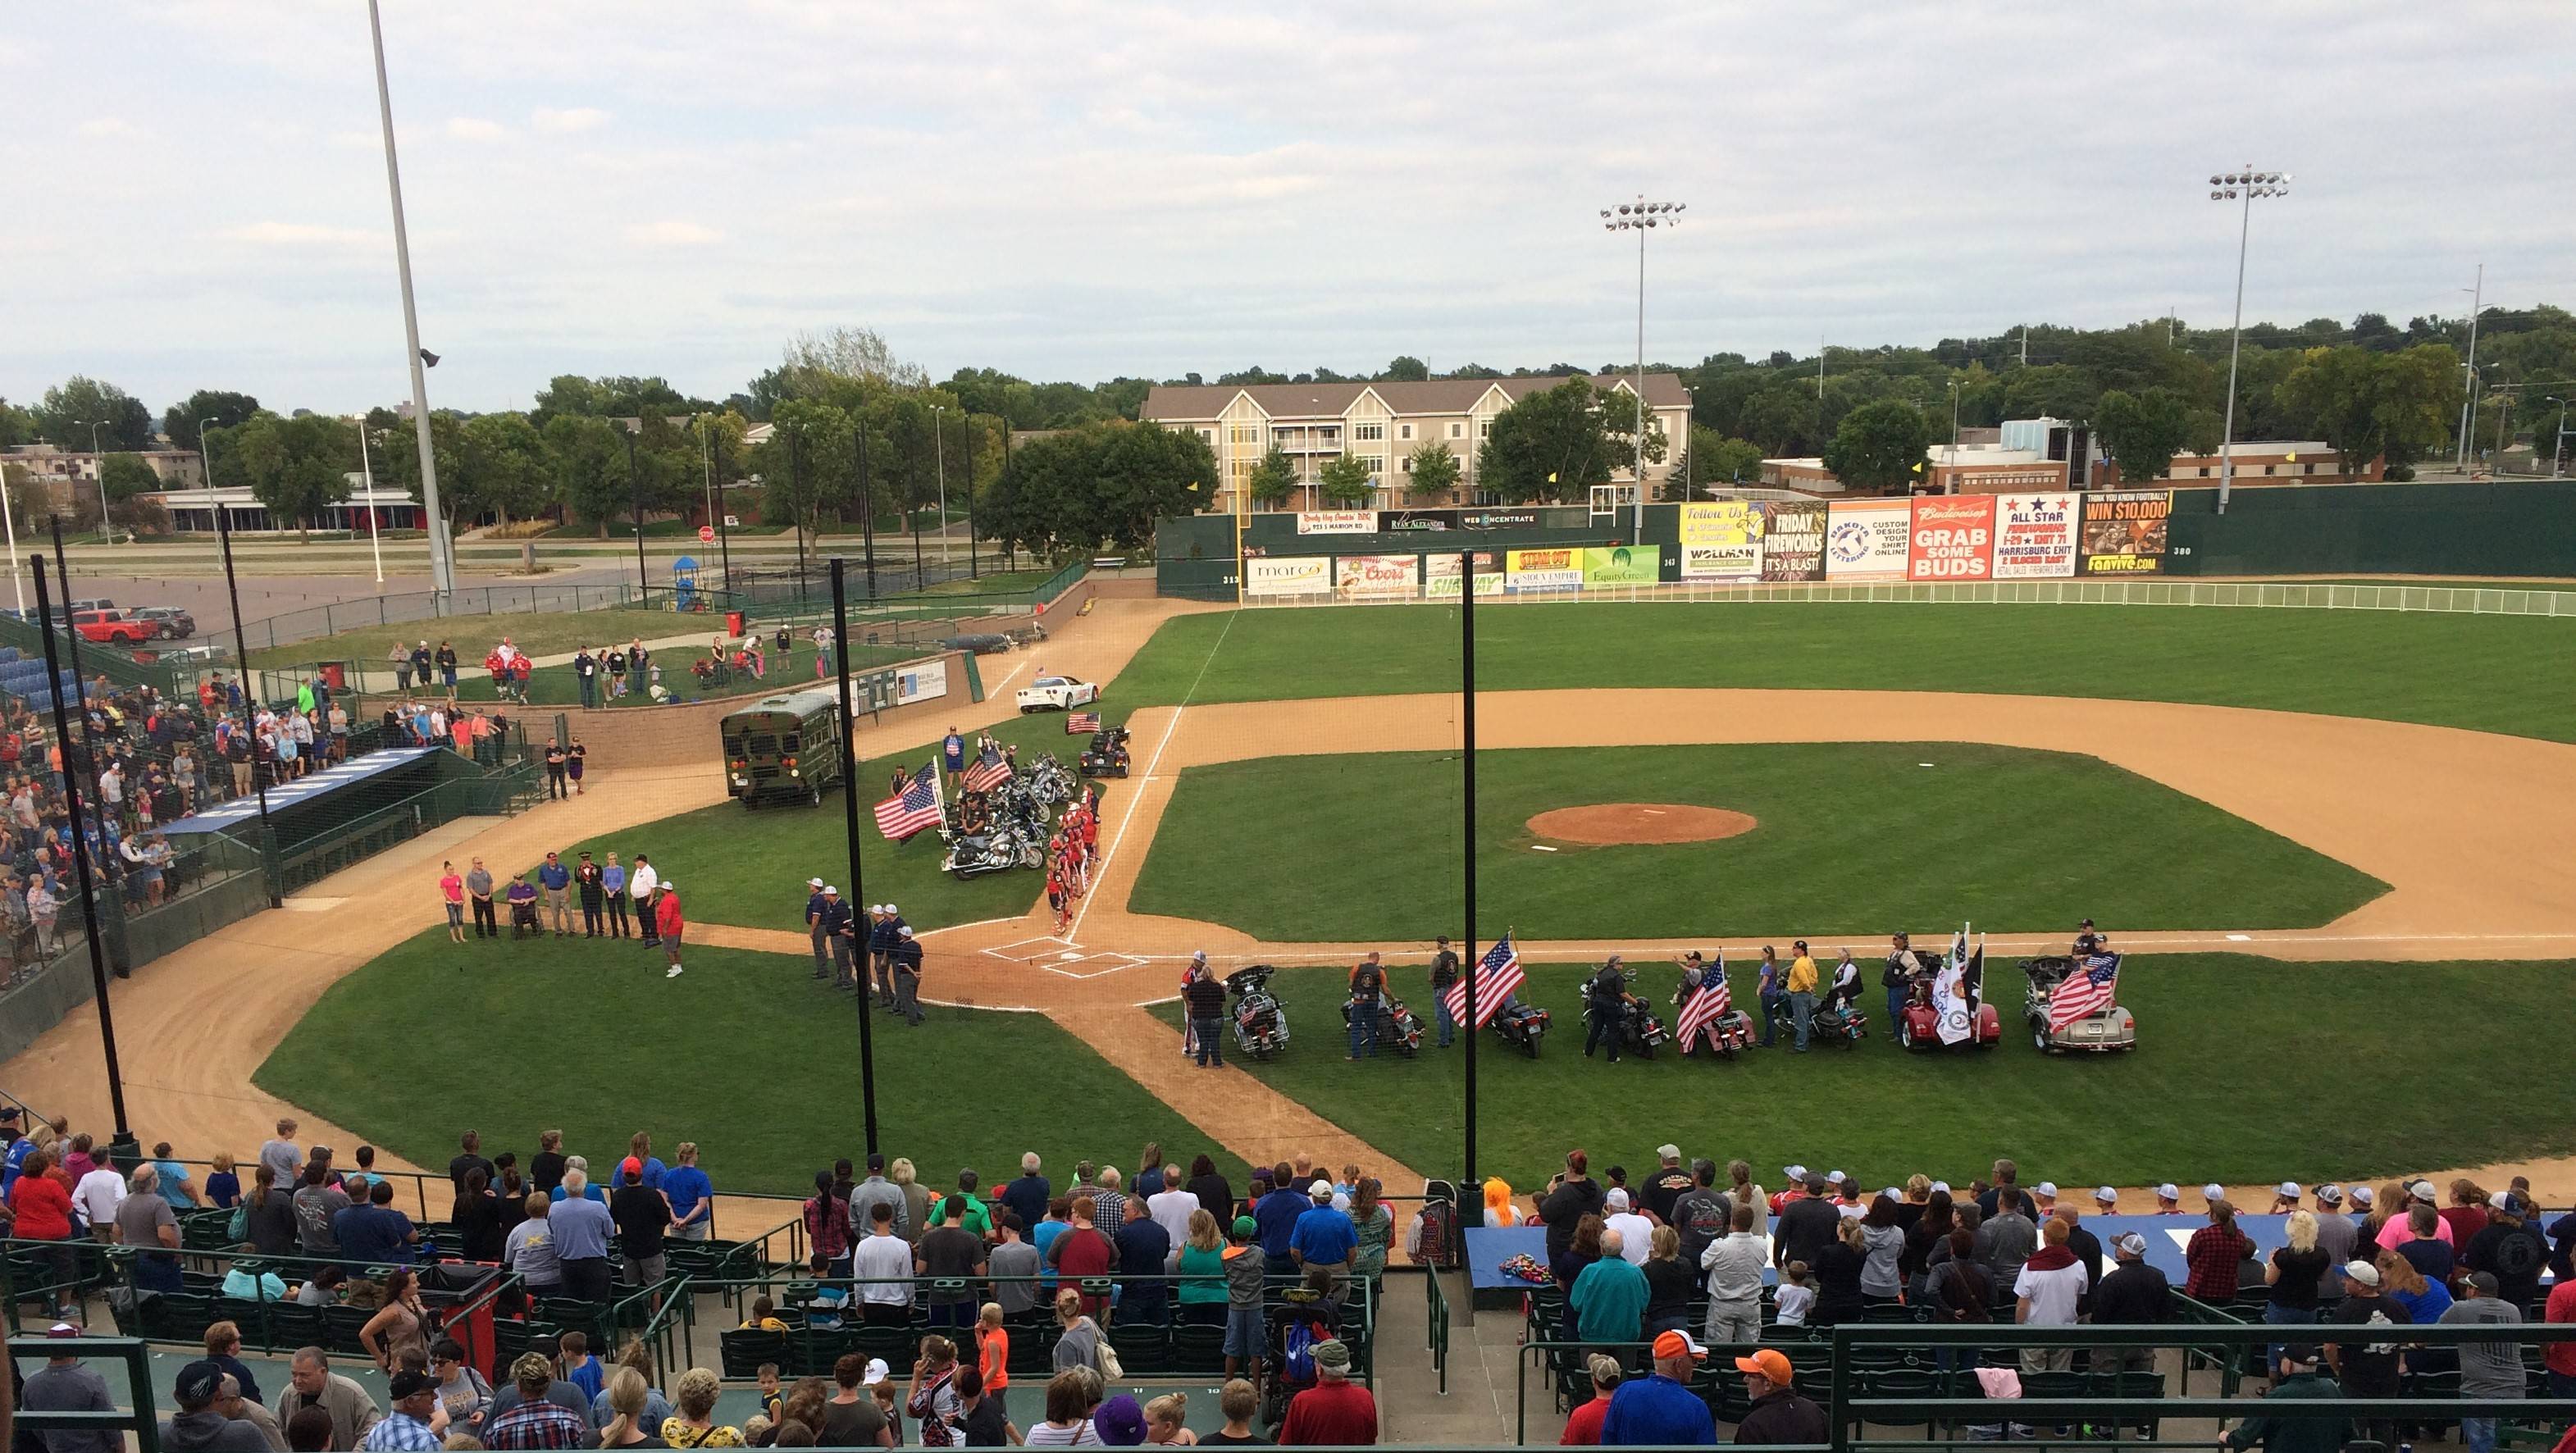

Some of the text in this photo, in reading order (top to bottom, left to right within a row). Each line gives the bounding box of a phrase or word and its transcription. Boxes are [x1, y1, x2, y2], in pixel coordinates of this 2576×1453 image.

[2087, 492, 2168, 503] THINK YOU KNOW FOOTBALL?
[1686, 507, 1742, 520] Follow Us
[1917, 506, 1987, 520] Budweiser
[2011, 512, 2063, 522] ALL STAR
[2086, 501, 2167, 521] WIN $10,000
[1410, 519, 1445, 528] ALEXANDER
[1776, 513, 1813, 533] FRIDAY
[2006, 523, 2067, 534] FIREWORKS
[1830, 522, 1870, 539] DAKOTA
[1764, 533, 1822, 553] FIREWORKS
[1915, 528, 1987, 548] GRAB
[2034, 534, 2054, 544] EXIT
[2057, 534, 2067, 544] 71
[1690, 549, 1755, 559] WOLLMAN
[1830, 544, 1870, 563] LETTERING
[1926, 546, 1975, 558] SOME
[1999, 545, 2072, 556] HARRISBURG EXIT
[2173, 547, 2191, 555] 380
[1664, 558, 1676, 567] 343
[1765, 558, 1819, 572] IT'S A BLAST!
[2002, 557, 2008, 565] 2
[2045, 555, 2067, 563] EAST
[1257, 564, 1321, 577] marco
[1365, 565, 1406, 581] Coors
[1914, 558, 1986, 576] BUDS
[1997, 566, 2011, 576] RETAIL
[2013, 565, 2027, 575] SALES
[2054, 564, 2071, 573] SHOWS
[1223, 576, 1239, 585] 313
[1522, 572, 1579, 581] SIOUX EMPIRE
[452, 1411, 471, 1423] MOM
